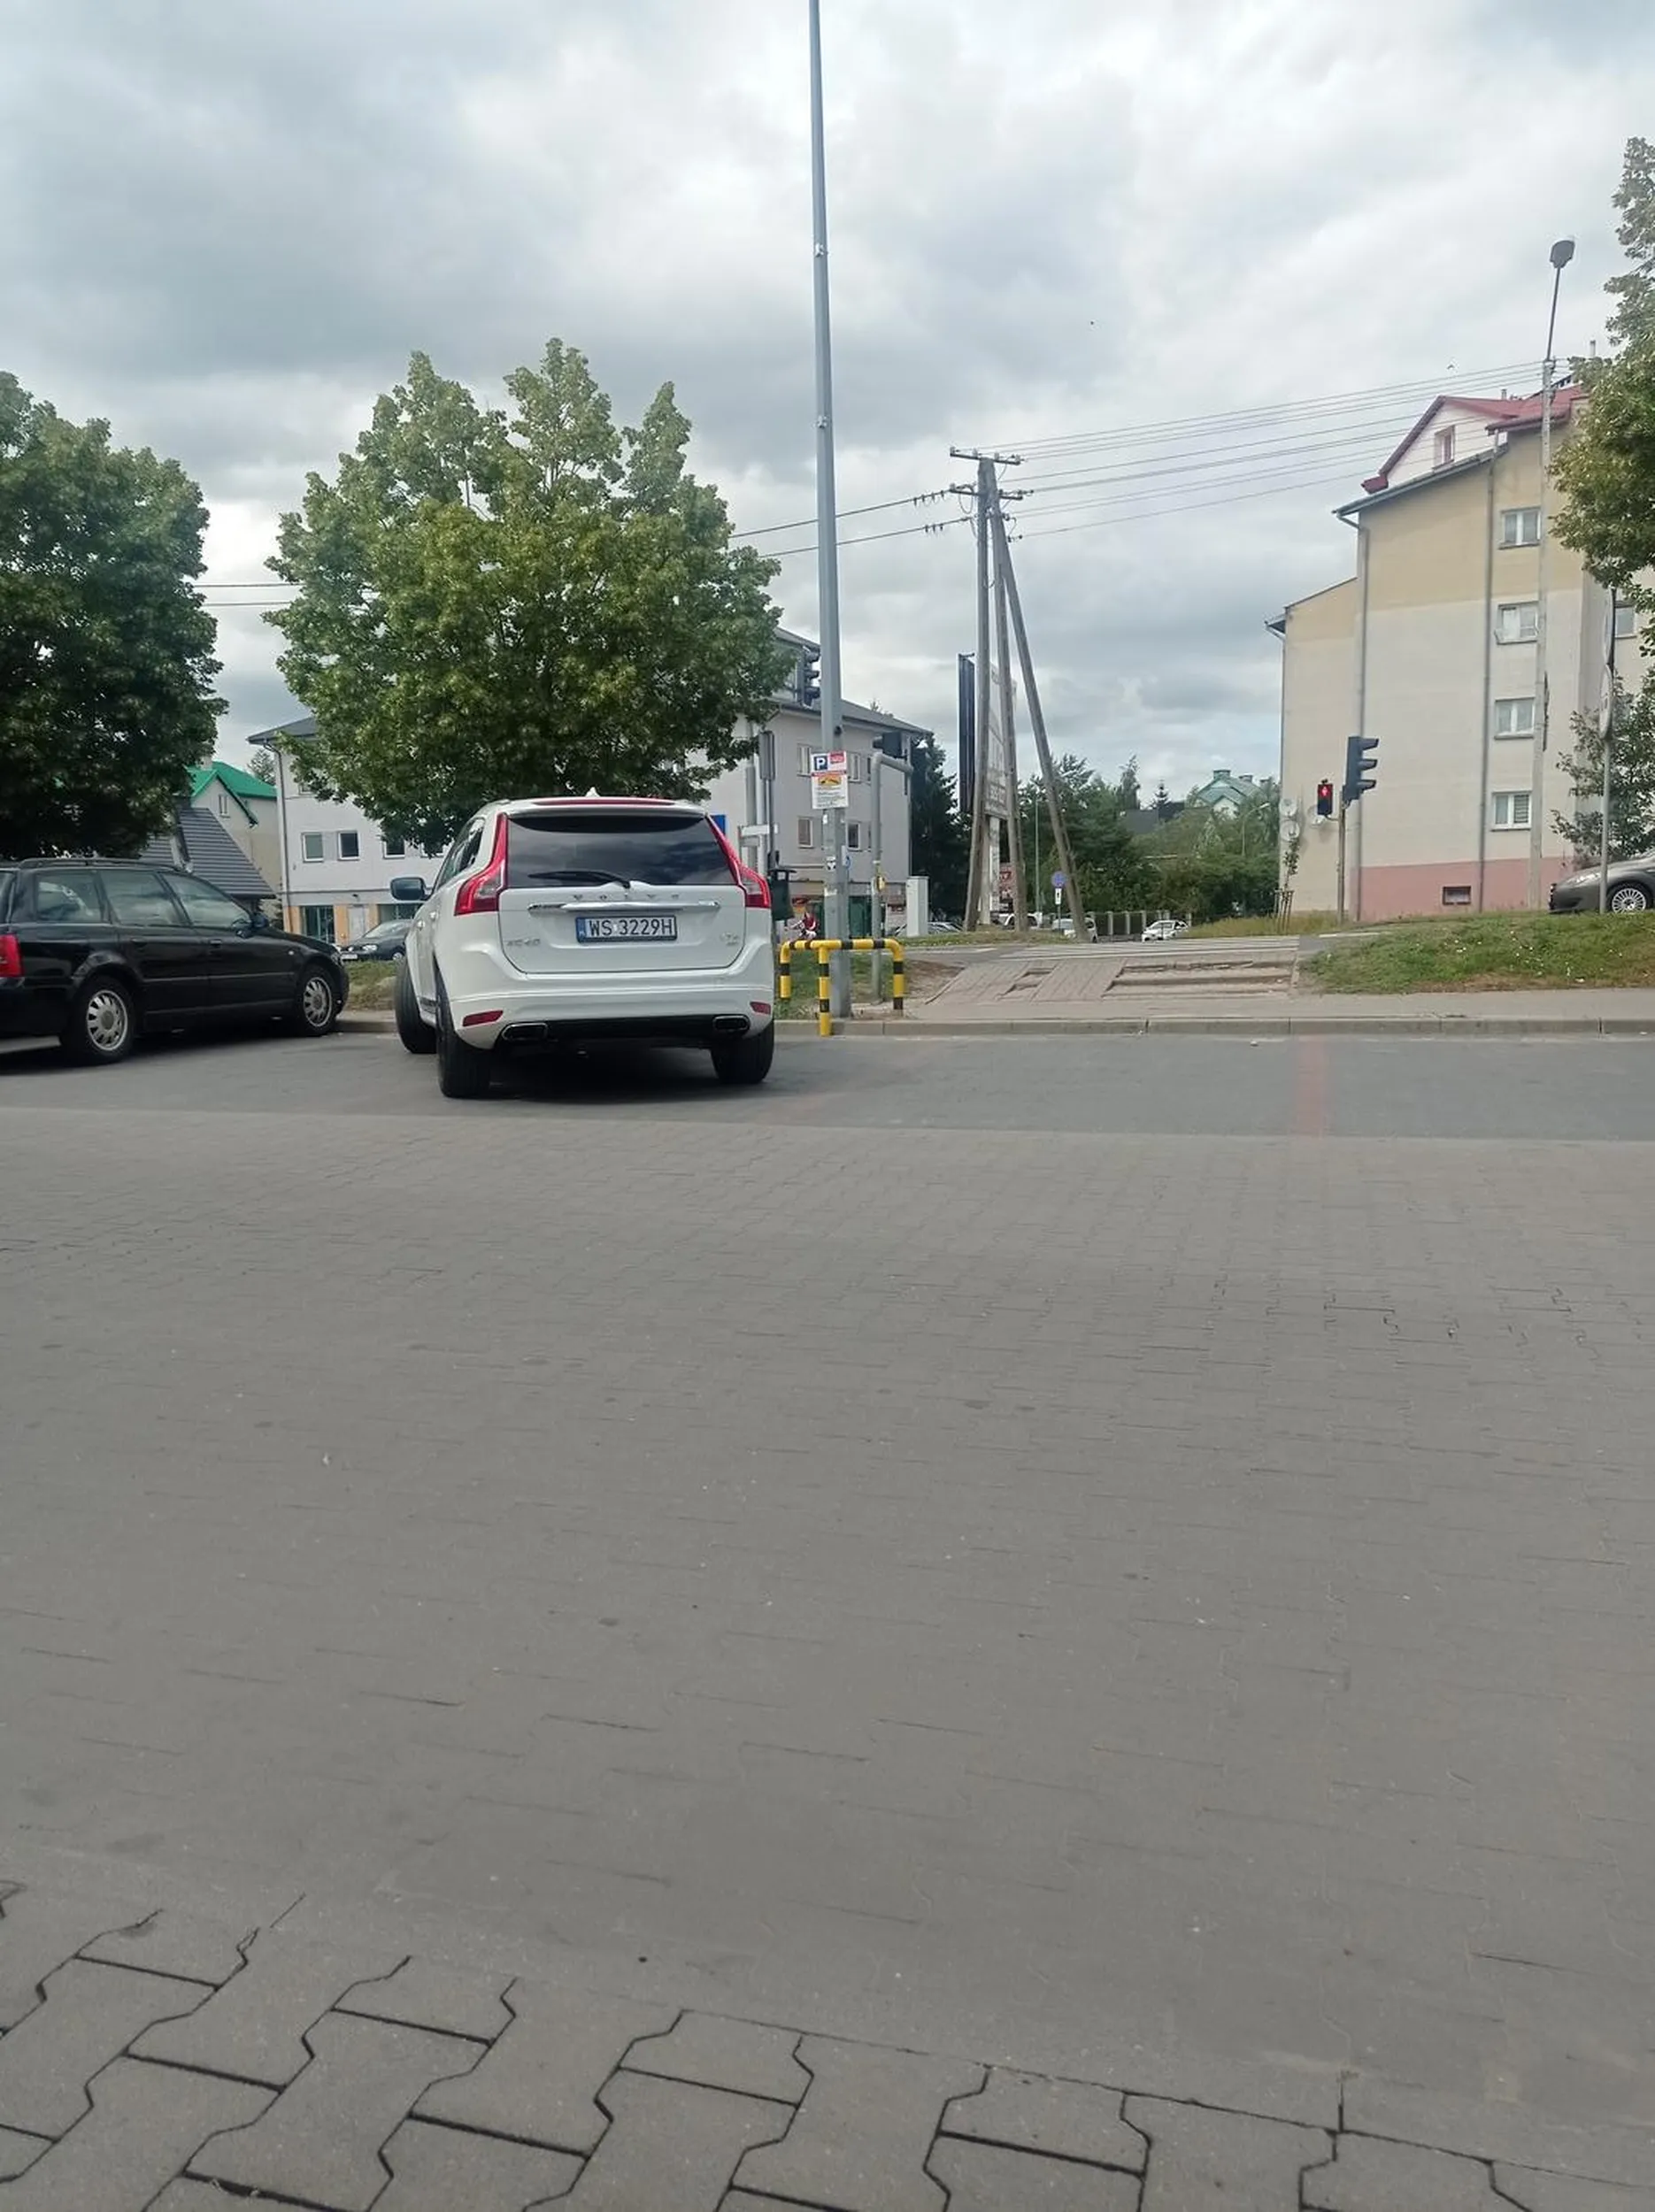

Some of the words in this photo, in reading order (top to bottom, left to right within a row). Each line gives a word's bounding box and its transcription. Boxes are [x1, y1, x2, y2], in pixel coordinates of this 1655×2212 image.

[816, 757, 827, 770] P
[589, 918, 612, 936] WS
[619, 918, 673, 935] 3229H
